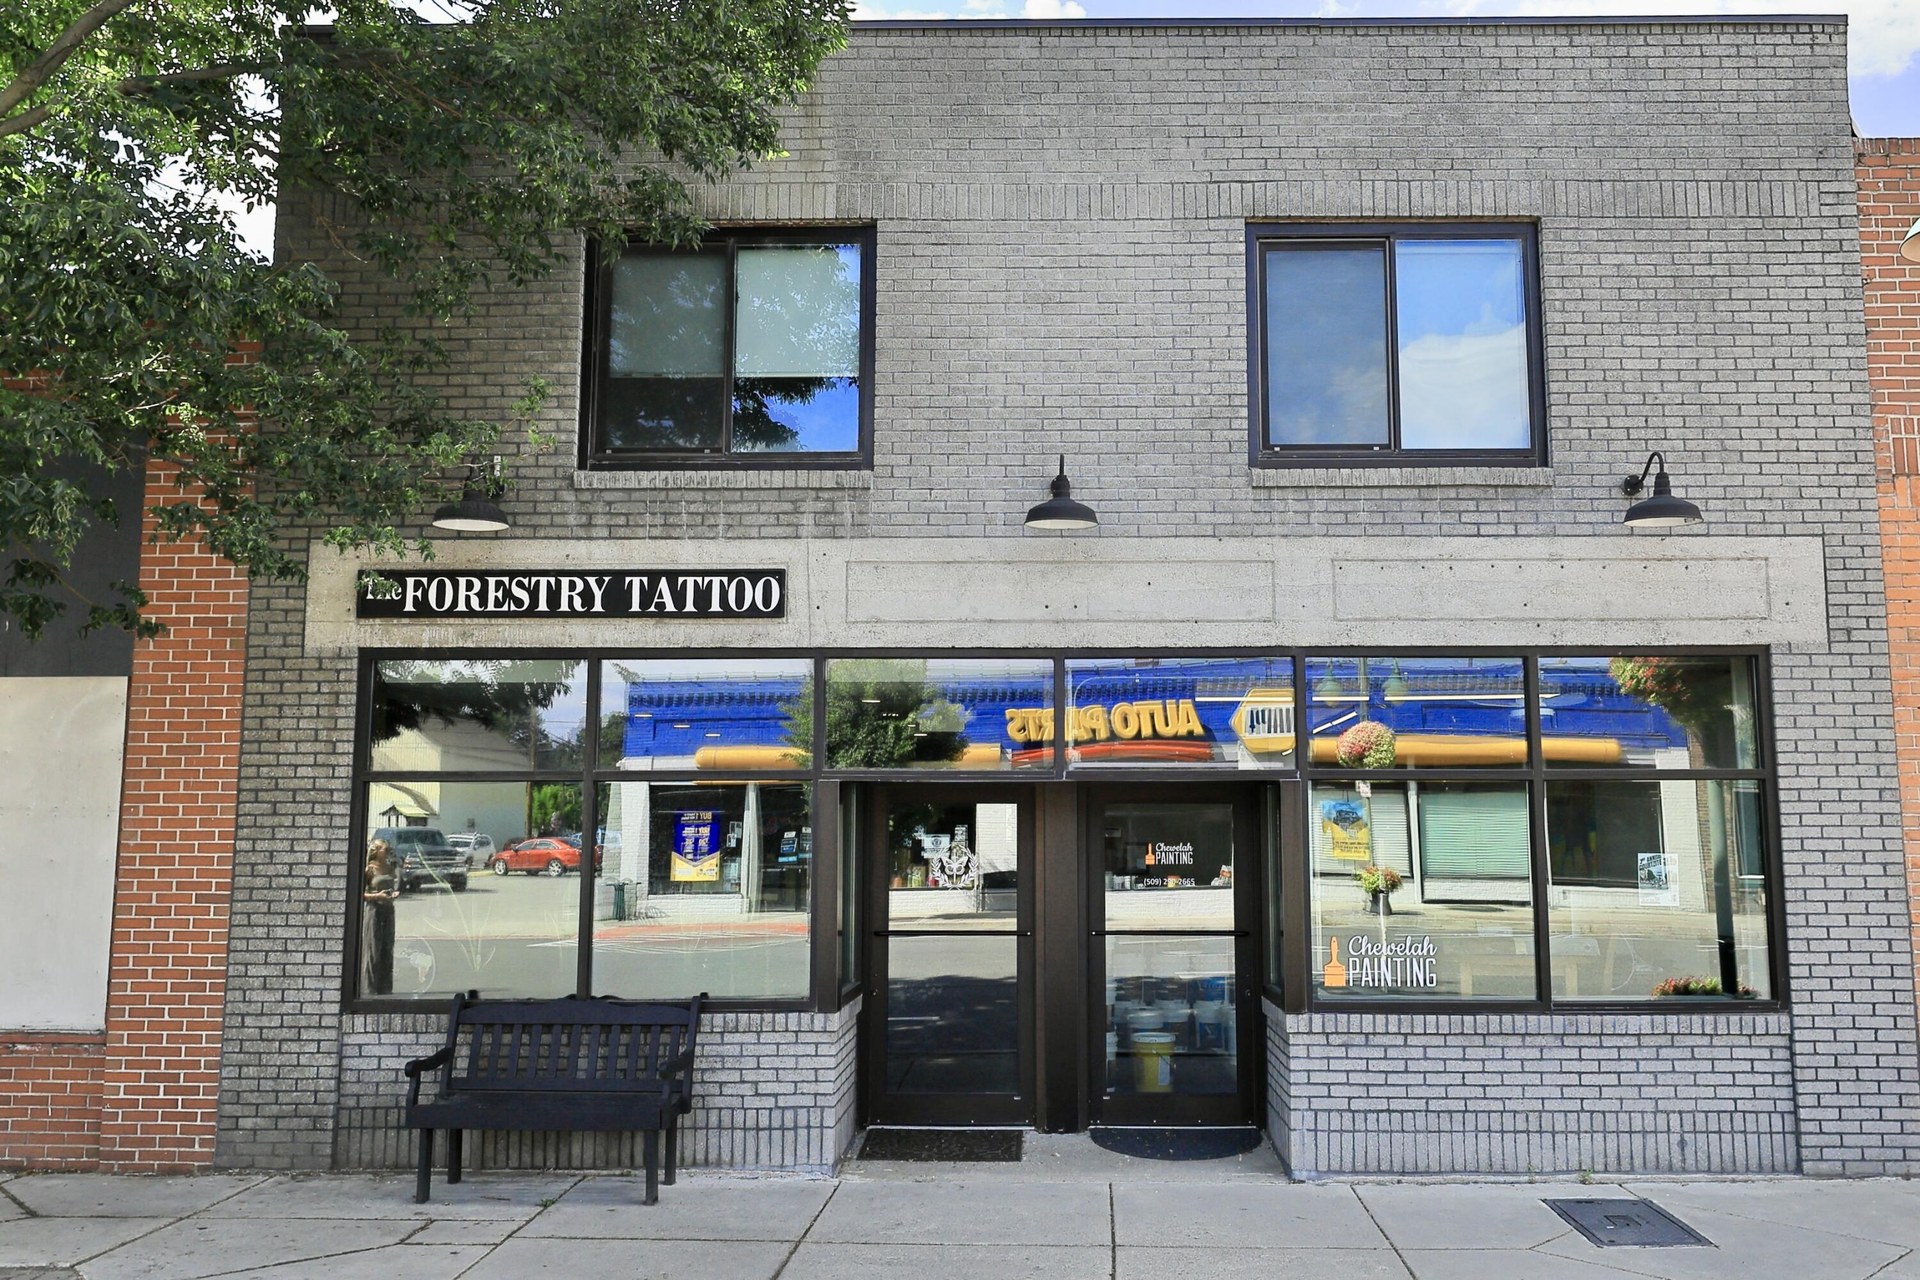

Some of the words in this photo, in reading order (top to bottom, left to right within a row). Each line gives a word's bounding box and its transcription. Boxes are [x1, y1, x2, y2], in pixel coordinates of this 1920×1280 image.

[403, 576, 612, 613] FORESTRY
[624, 576, 780, 613] TATTOO
[1155, 842, 1194, 852] Chewelah
[1155, 852, 1194, 865] PAINTING
[1143, 878, 1162, 887] (509)
[1348, 935, 1437, 956] Chewelah
[1349, 957, 1437, 987] PAINTING
